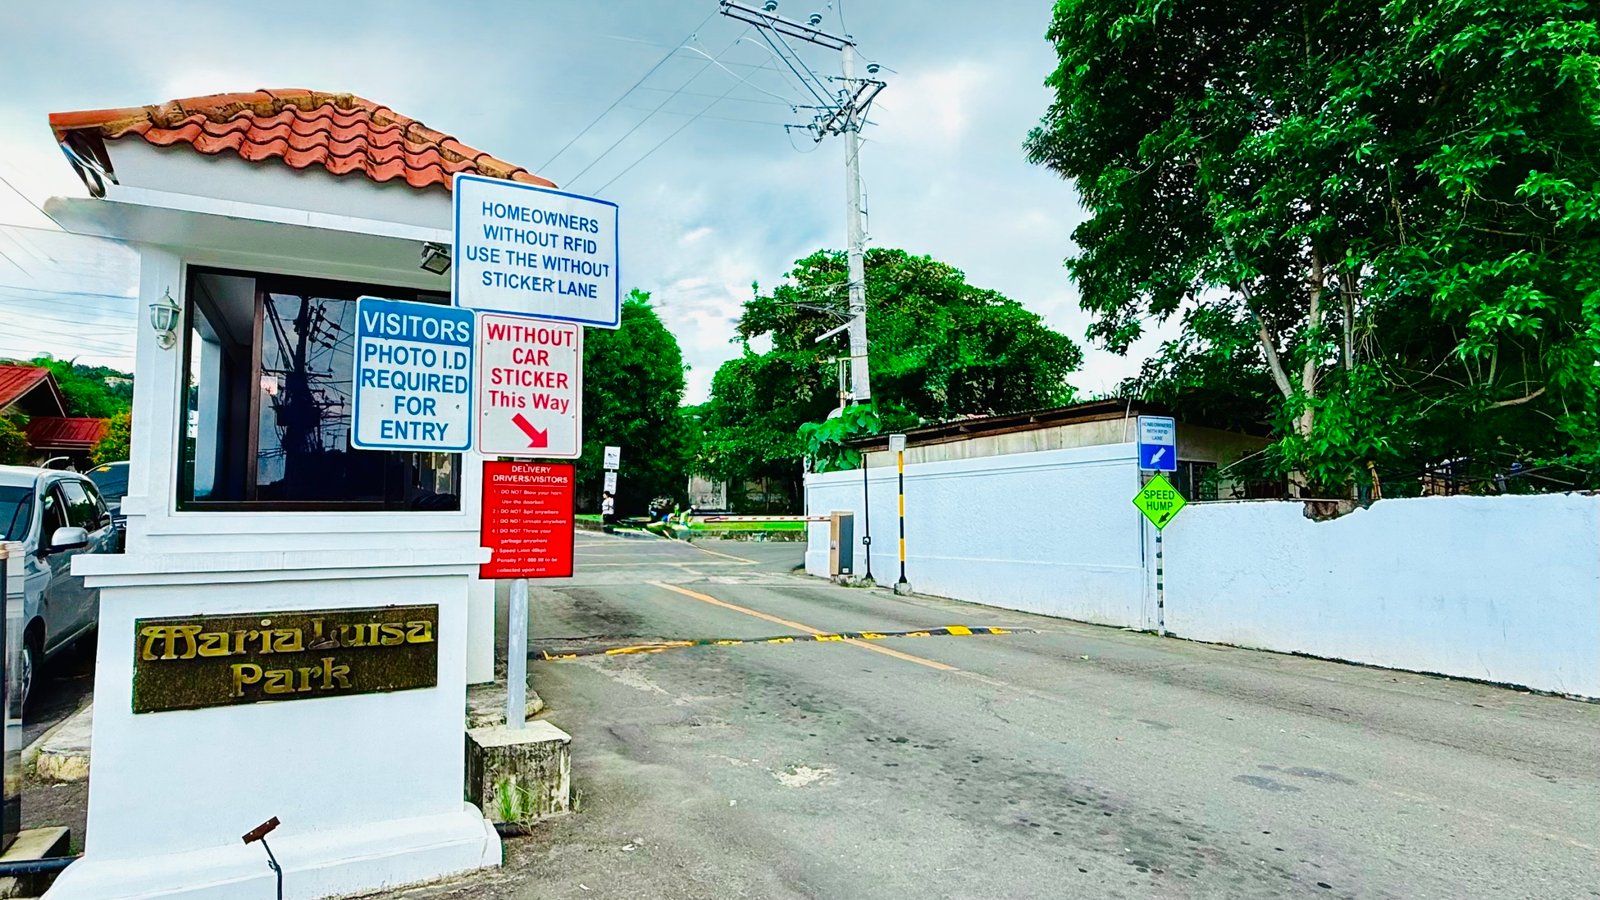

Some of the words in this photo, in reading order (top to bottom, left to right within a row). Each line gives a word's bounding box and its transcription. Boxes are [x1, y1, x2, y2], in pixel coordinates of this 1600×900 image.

[482, 201, 599, 234] HOMEOWNERS
[483, 223, 559, 249] WITHOUT
[563, 236, 598, 255] RFID
[466, 245, 500, 263] USE
[506, 250, 537, 269] THE
[542, 254, 609, 278] WITHOUT
[482, 271, 552, 292] STICKER
[558, 282, 598, 299] LANE
[363, 310, 470, 343] VISITORS
[486, 322, 574, 347] WITHOUT
[364, 343, 437, 366] PHOTO
[443, 350, 467, 370] I.D
[512, 347, 549, 367] CAR
[361, 368, 468, 394] REQUIRED
[491, 367, 569, 389] STICKER
[394, 396, 436, 416] FOR
[488, 390, 526, 409] This
[532, 393, 569, 415] Way
[380, 419, 449, 441] ENTRY
[492, 474, 568, 484] DRIVERS/VISITORS
[511, 465, 551, 474] DELIVERY
[1143, 489, 1175, 500] SPEED
[1146, 501, 1174, 511] HUMP
[140, 618, 305, 661] Maria
[307, 616, 435, 650] Luisa
[229, 657, 352, 697] Park
